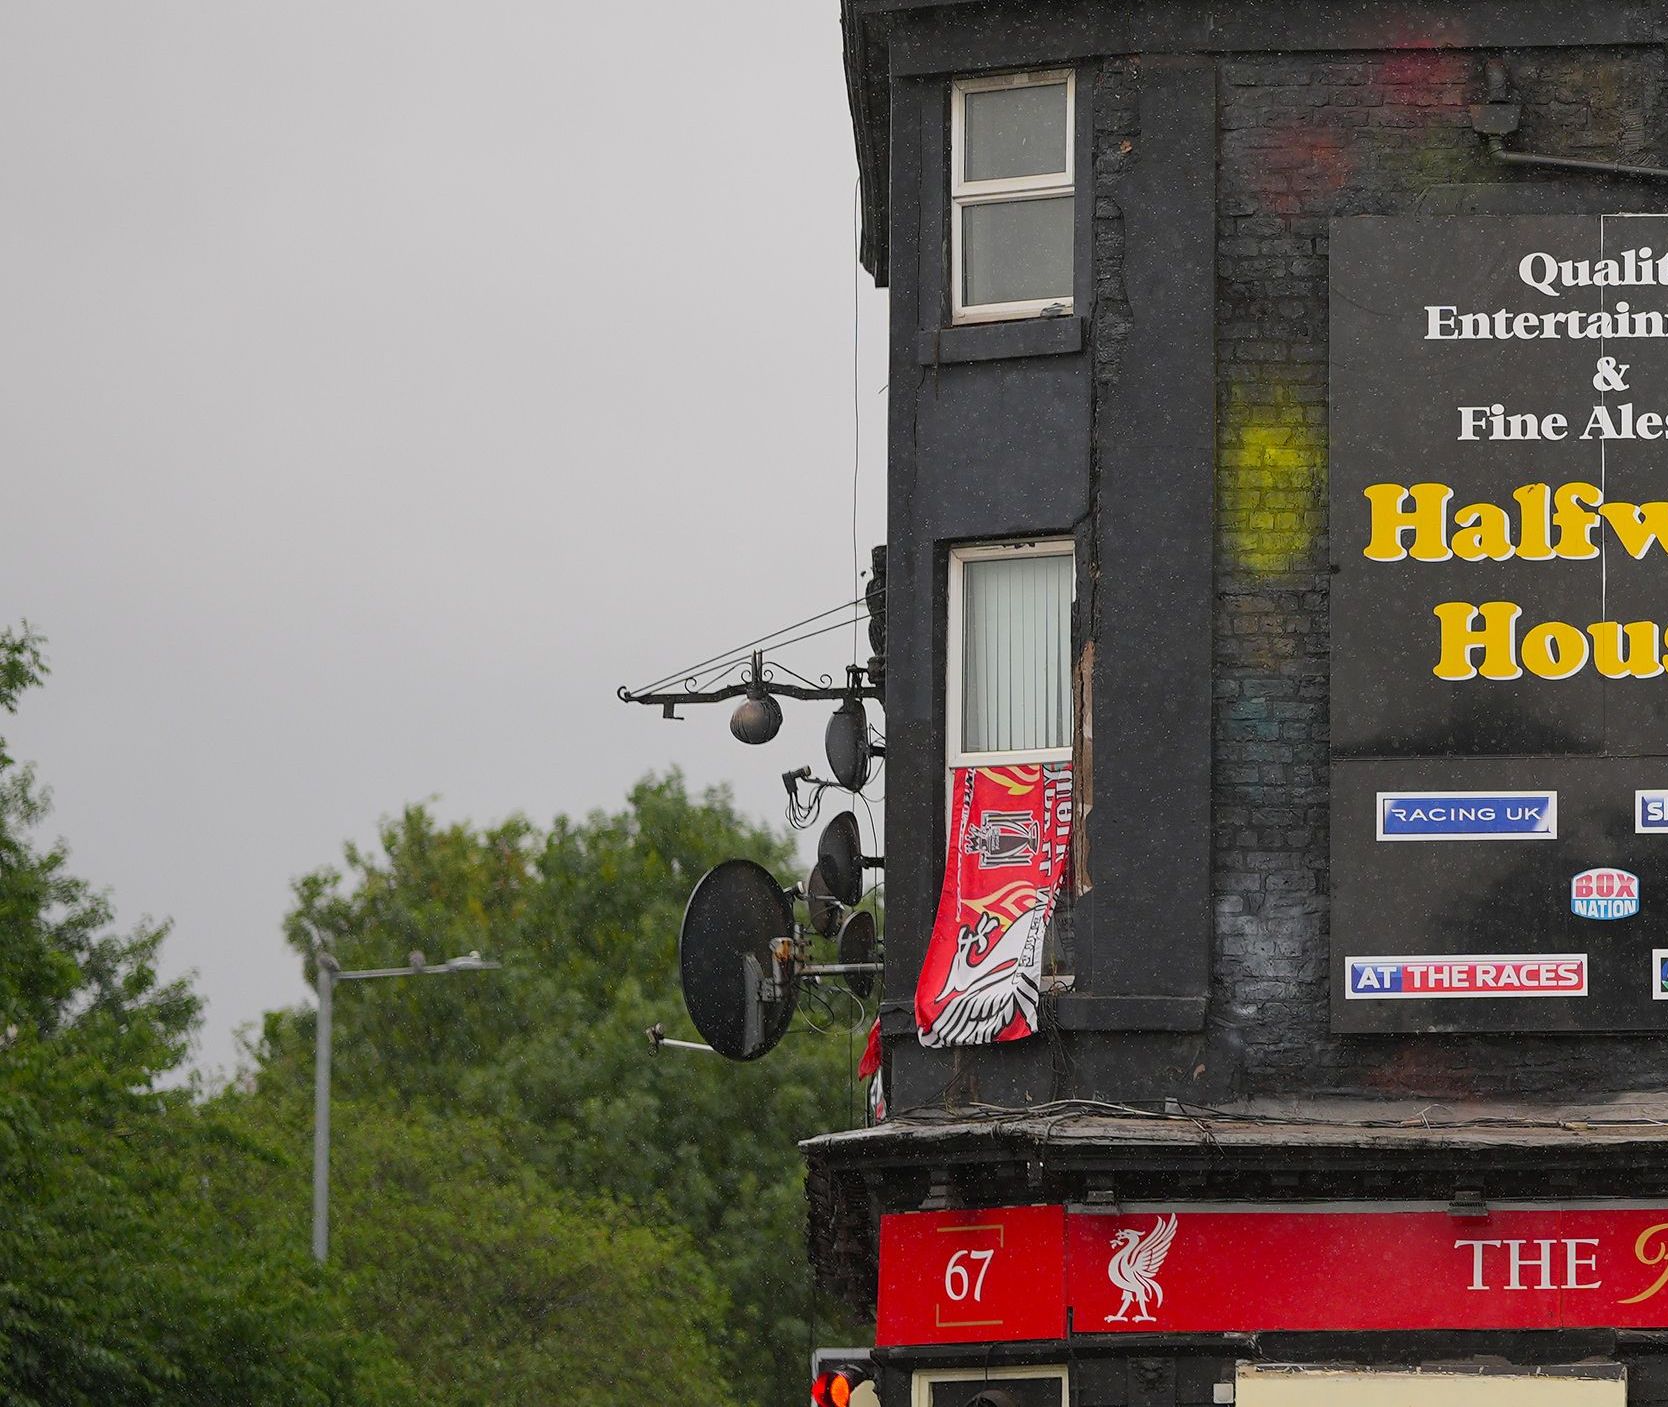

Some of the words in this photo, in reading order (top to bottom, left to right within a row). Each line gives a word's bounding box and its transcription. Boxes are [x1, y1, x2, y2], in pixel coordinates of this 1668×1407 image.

[1592, 356, 1630, 392] &
[1457, 403, 1568, 441] Fine
[1390, 805, 1497, 823] RACING
[1505, 805, 1542, 822] UK
[1575, 873, 1636, 898] BOX
[1574, 900, 1637, 918] NATION
[1355, 966, 1399, 990] AT
[1407, 964, 1471, 989] THE
[1475, 961, 1581, 988] RACES
[944, 1248, 995, 1302] 67
[1453, 1236, 1602, 1291] THE
